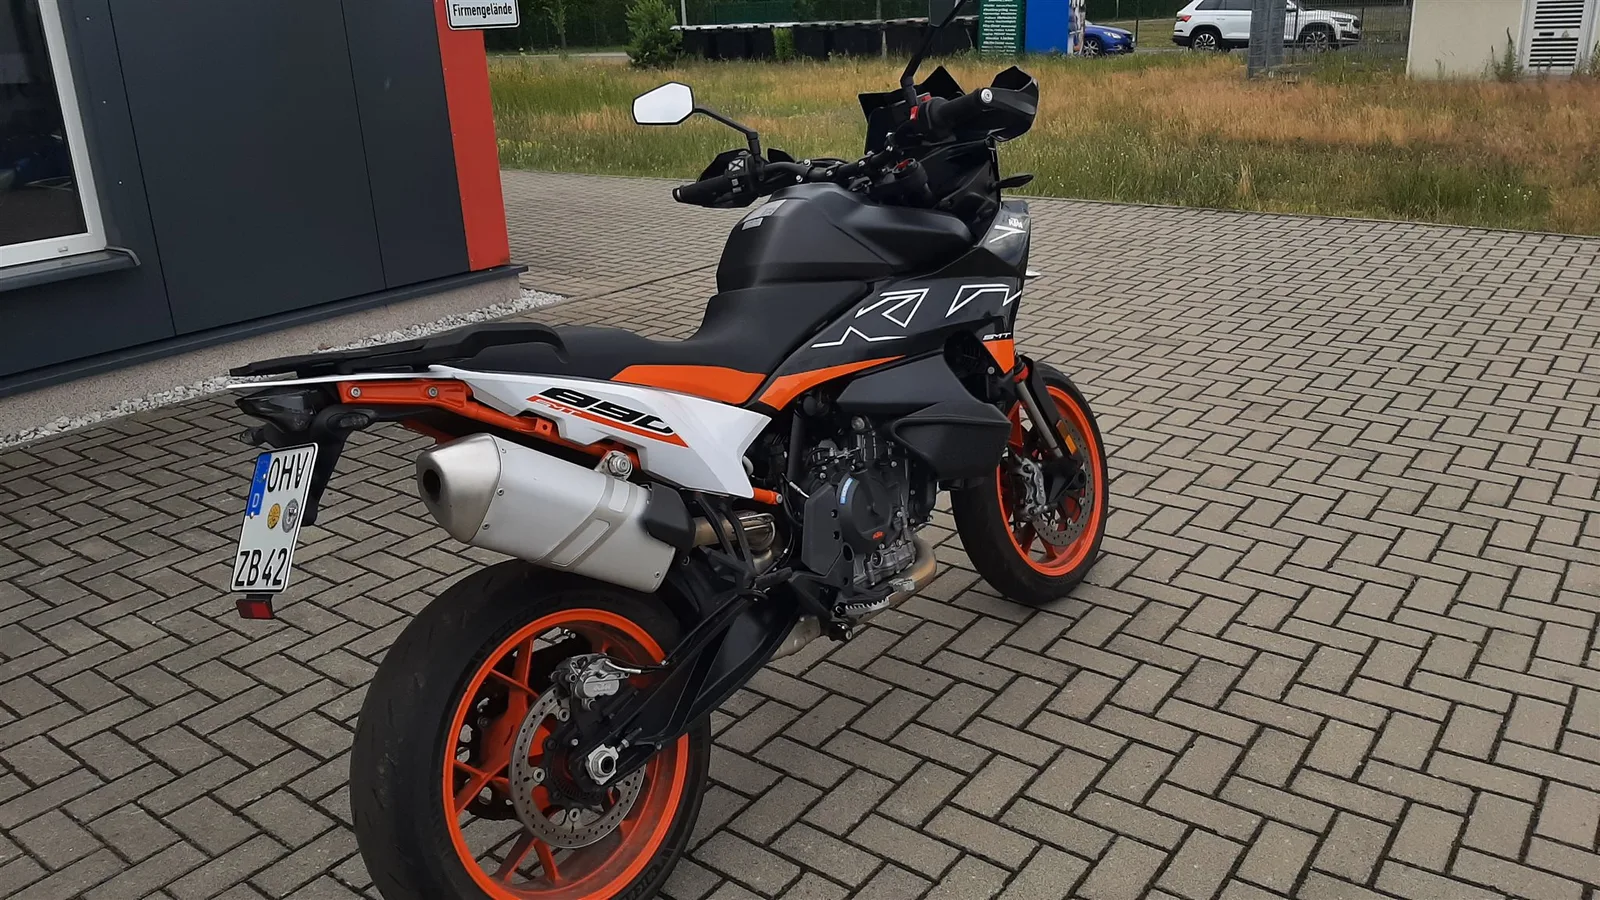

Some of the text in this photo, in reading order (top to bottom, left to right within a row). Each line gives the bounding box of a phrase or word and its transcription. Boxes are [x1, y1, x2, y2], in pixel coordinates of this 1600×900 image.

[453, 3, 513, 18] Firmengelände
[1008, 217, 1023, 229] KTM
[982, 332, 1012, 341] SMT
[267, 452, 310, 493] OHV
[251, 493, 260, 508] D
